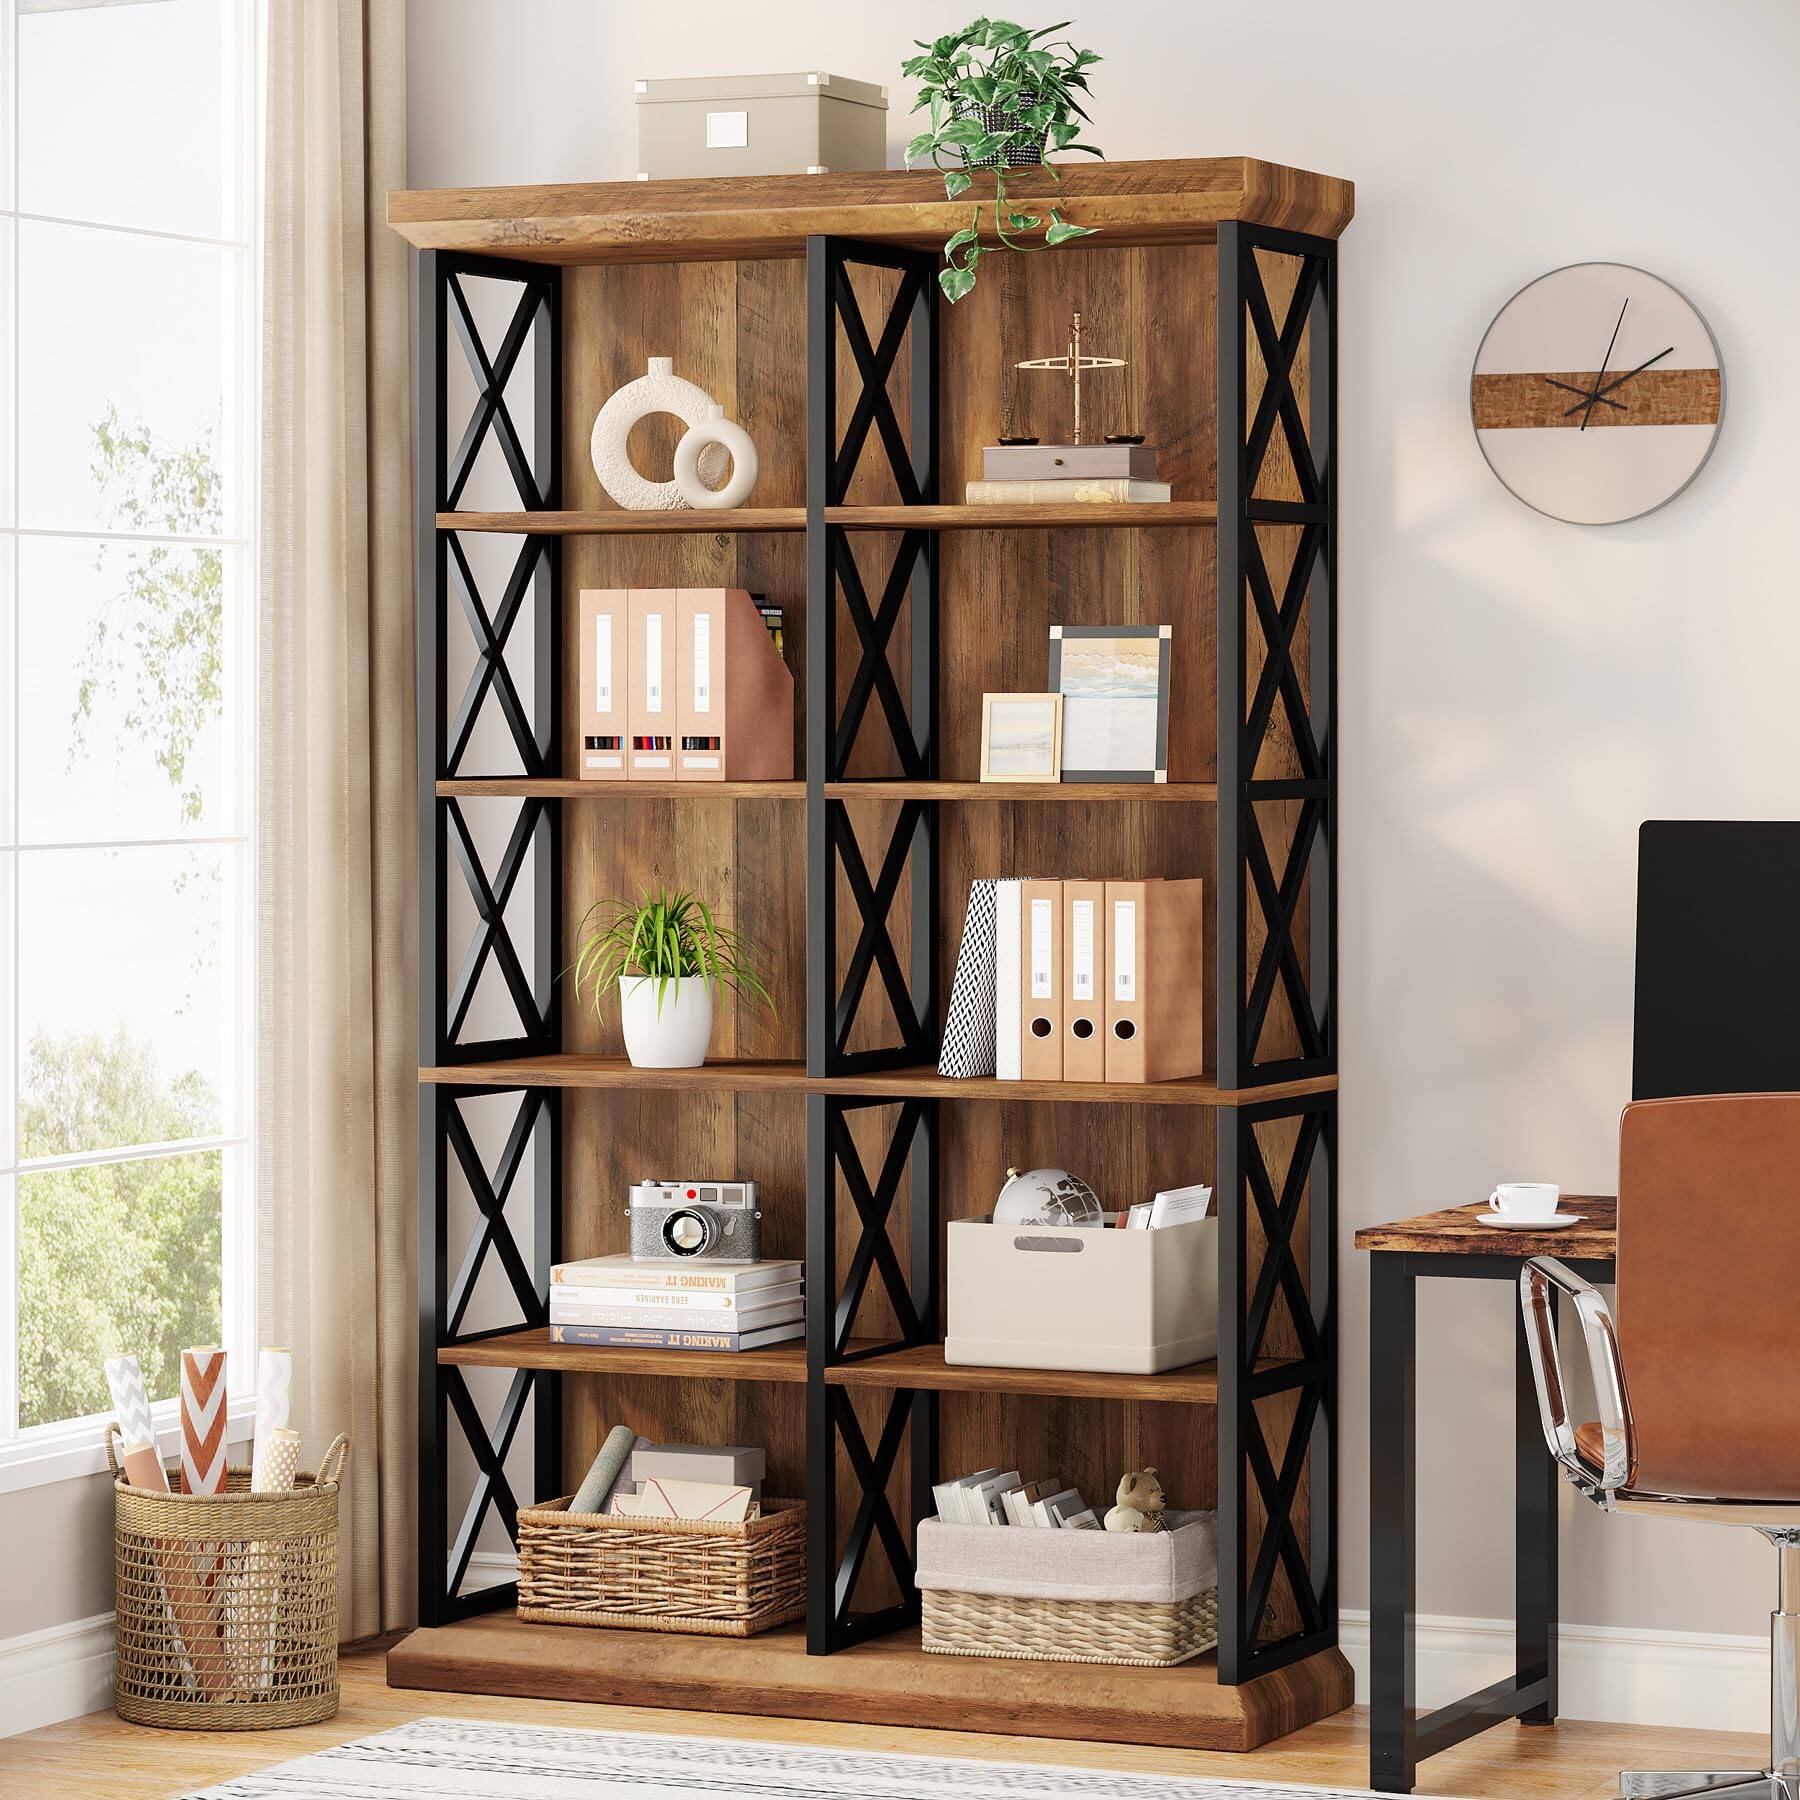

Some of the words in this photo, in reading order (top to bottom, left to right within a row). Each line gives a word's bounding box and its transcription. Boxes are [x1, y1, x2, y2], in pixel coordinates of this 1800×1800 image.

[666, 1275, 677, 1286] IT
[681, 1275, 726, 1288] MAKING
[635, 1294, 669, 1304] SAARINEN
[671, 1295, 688, 1305] EERO
[668, 1334, 681, 1346] IT
[683, 1335, 731, 1348] MAKING
